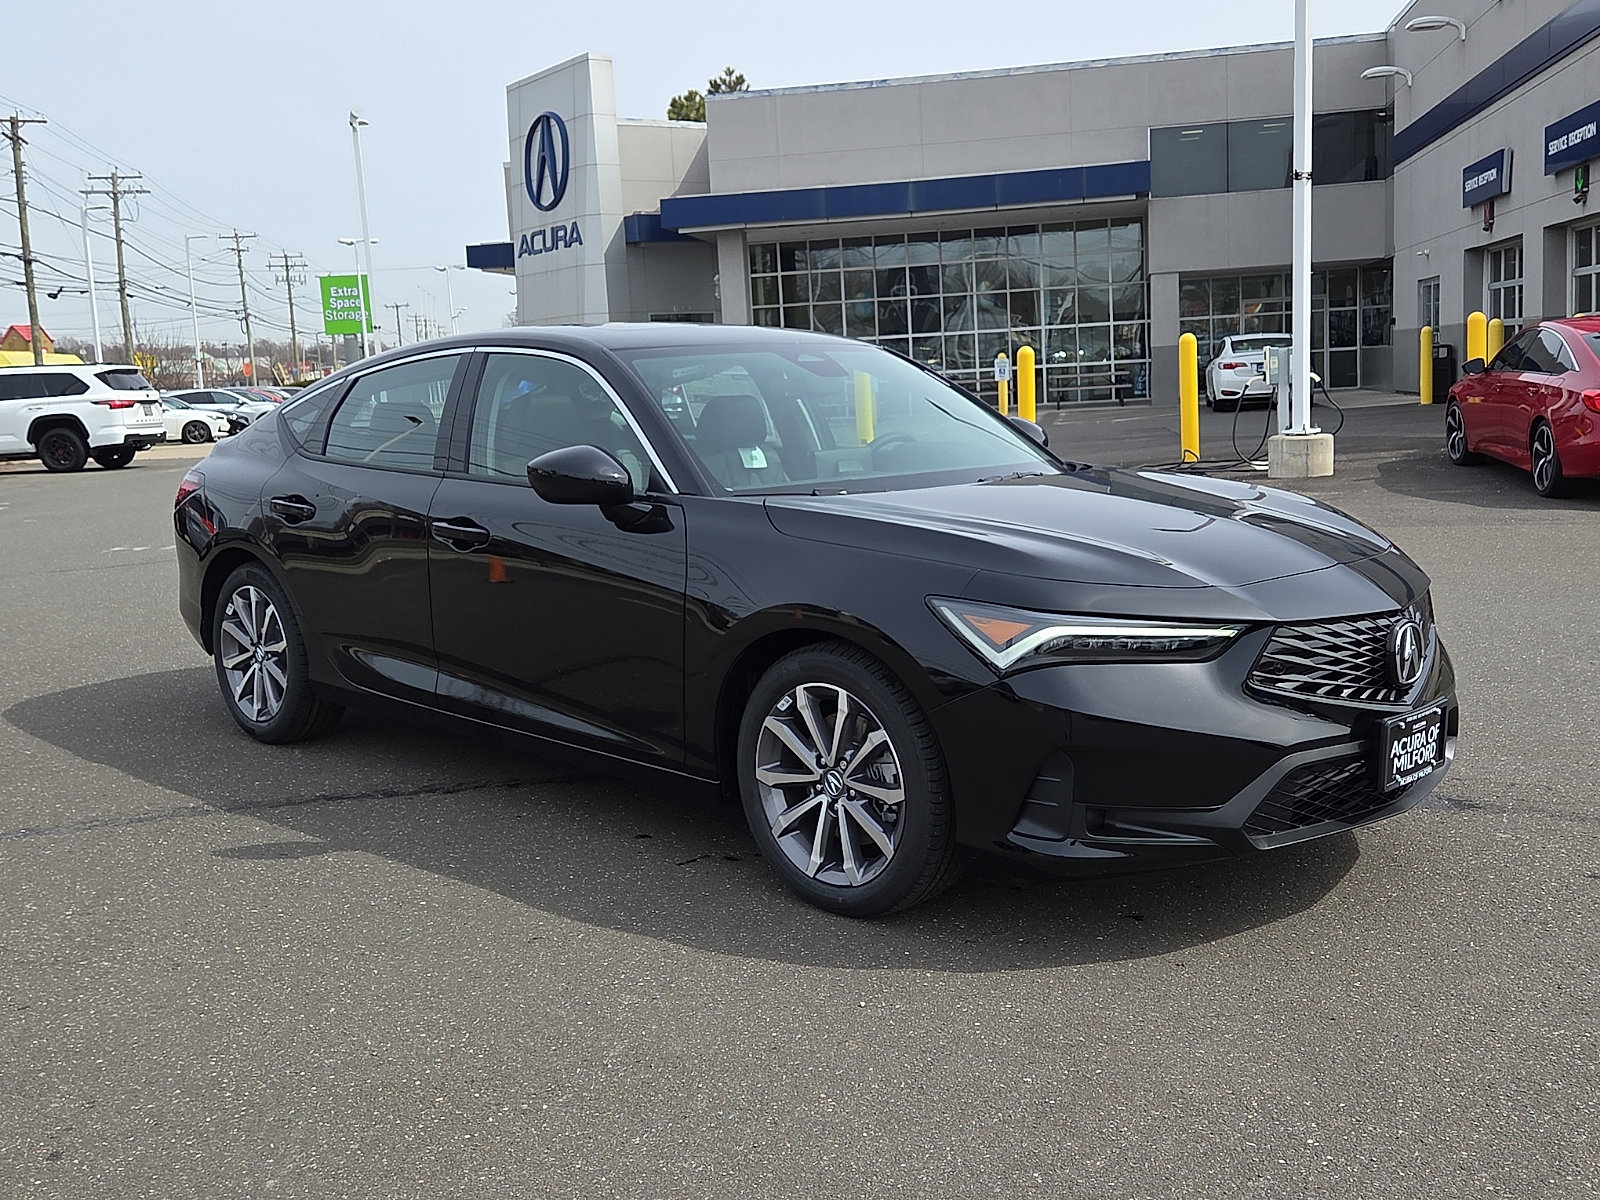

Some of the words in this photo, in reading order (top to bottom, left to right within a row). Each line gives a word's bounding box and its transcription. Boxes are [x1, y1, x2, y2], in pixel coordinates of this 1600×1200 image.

[1548, 134, 1568, 156] SERVICE
[1568, 121, 1597, 147] RECEPTION
[517, 221, 583, 259] ACURA
[330, 286, 358, 297] Extra
[1390, 731, 1426, 758] ACURA
[1428, 723, 1440, 742] OF
[1393, 742, 1436, 774] MILFORD
